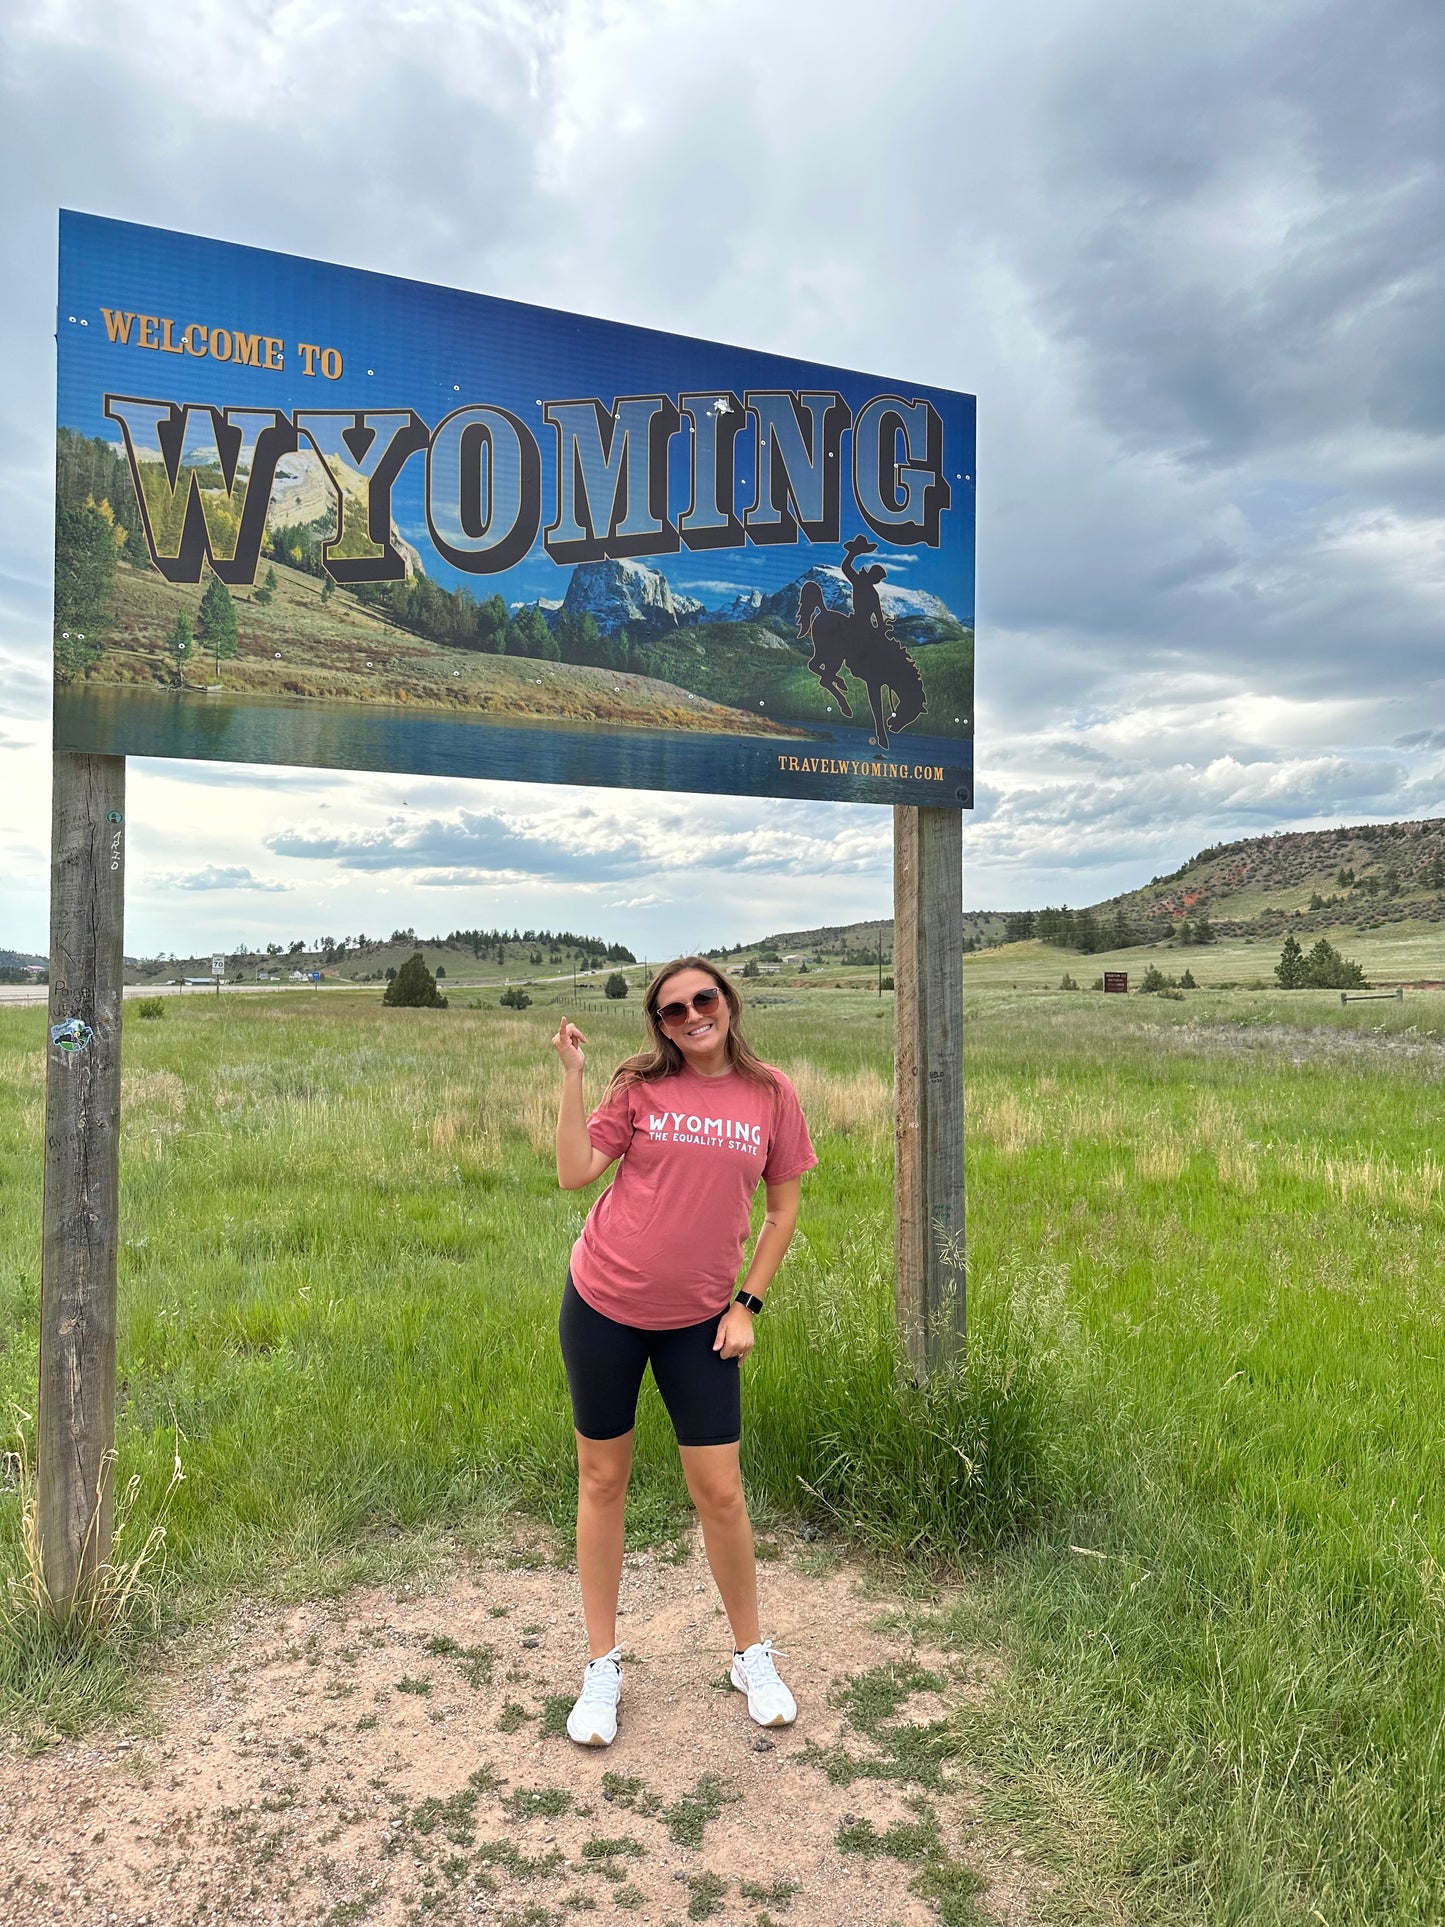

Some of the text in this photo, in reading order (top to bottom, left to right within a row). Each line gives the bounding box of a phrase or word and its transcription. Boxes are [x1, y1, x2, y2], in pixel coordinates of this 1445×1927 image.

[100, 307, 344, 380] WELCOME TO
[103, 390, 952, 586] WYOMING
[778, 755, 945, 781] TRAVELWYOMING.COM
[649, 1132, 757, 1155] THE EQUALITY STATE
[650, 1112, 761, 1145] WYOMING
